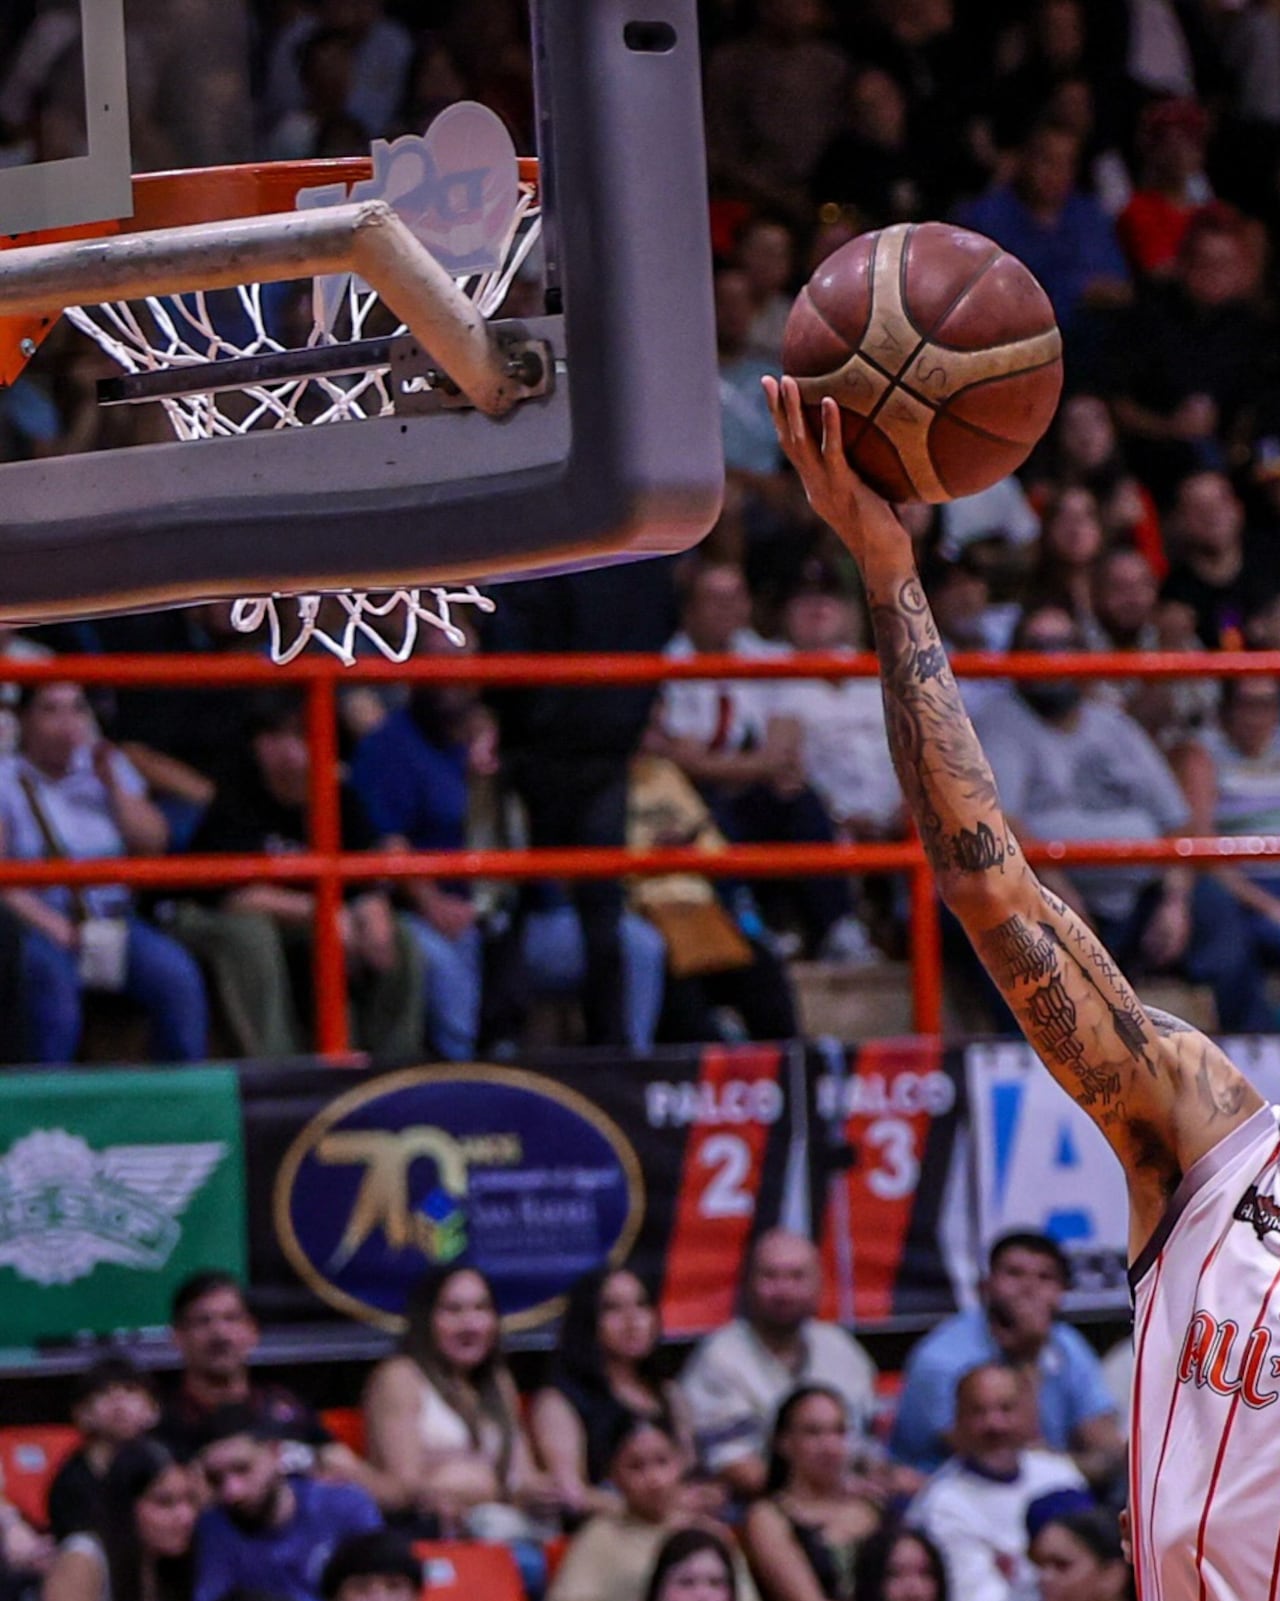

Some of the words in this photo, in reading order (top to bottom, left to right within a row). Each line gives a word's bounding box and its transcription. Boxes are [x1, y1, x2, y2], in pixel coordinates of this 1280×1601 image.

[644, 1078, 785, 1129] PALCO
[701, 1134, 757, 1219] 2
[865, 1119, 922, 1200] 3
[1176, 1309, 1278, 1410] ALL
